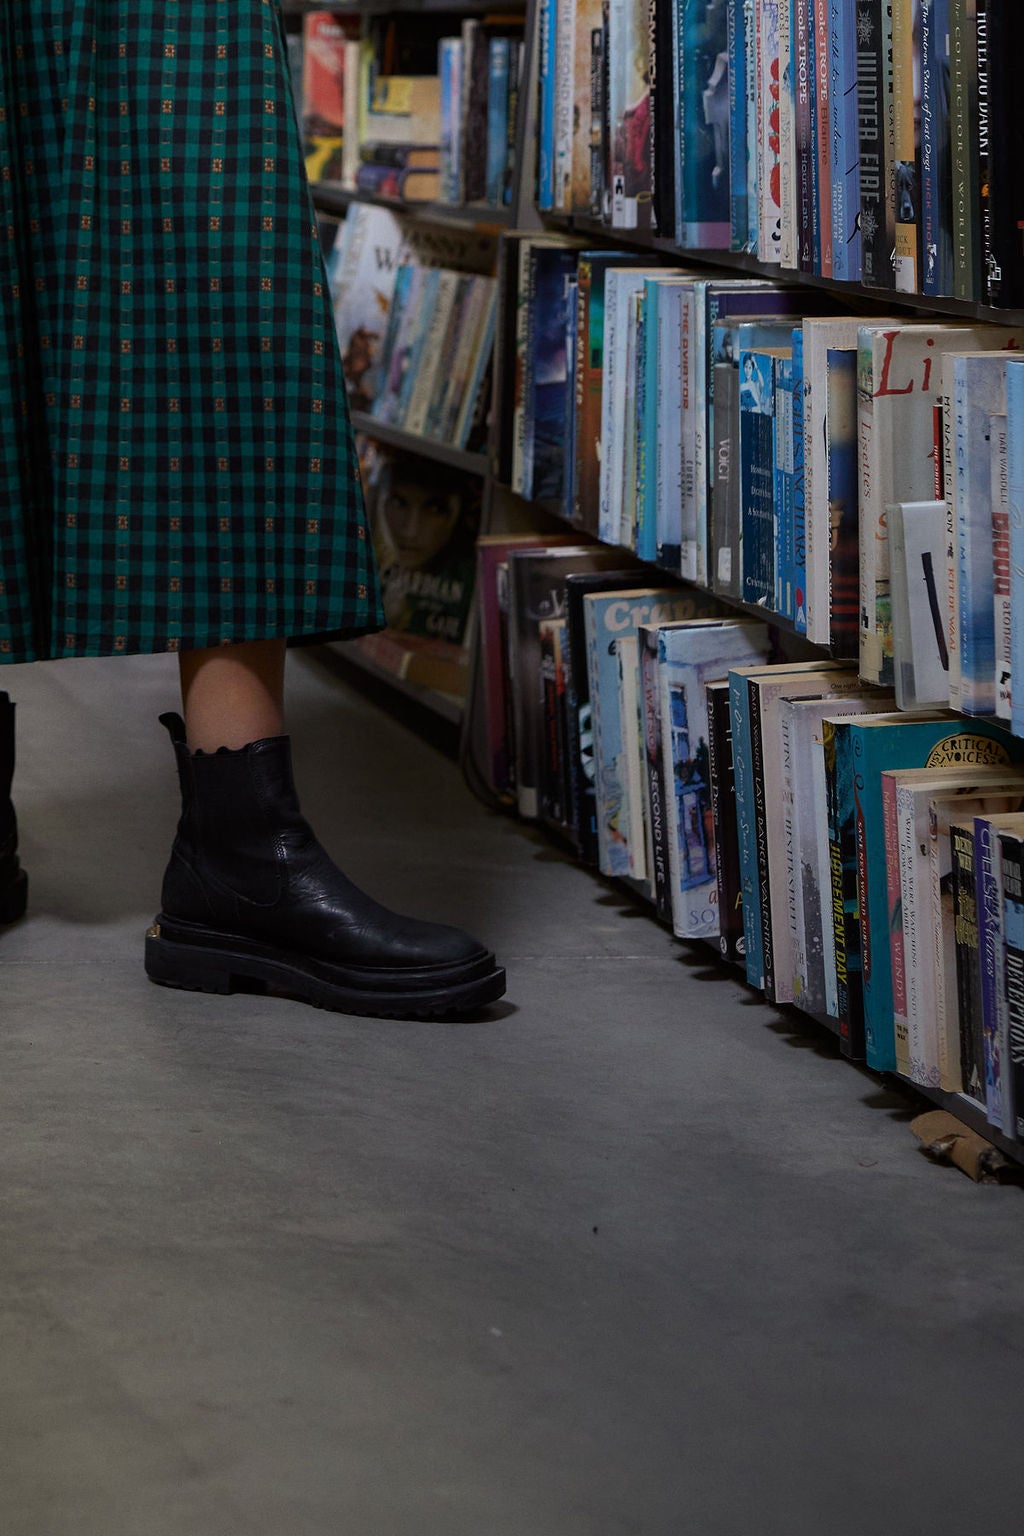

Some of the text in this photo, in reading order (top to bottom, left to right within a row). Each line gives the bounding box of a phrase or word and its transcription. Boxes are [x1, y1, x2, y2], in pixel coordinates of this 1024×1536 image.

[922, 4, 931, 25] The
[921, 28, 932, 67] Patron
[798, 43, 807, 104] TROPE
[819, 38, 828, 101] TROPE
[923, 70, 932, 102] Saint
[955, 27, 963, 149] COLLECTOR
[858, 51, 879, 204] WINTER FIRE
[921, 104, 932, 116] of
[923, 118, 932, 143] Lost
[821, 107, 829, 166] Blame
[801, 153, 809, 193] Hours
[922, 146, 933, 171] Dogs
[956, 159, 965, 174] of
[802, 198, 810, 229] Late
[958, 182, 966, 270] WORLDS
[806, 403, 812, 419] To
[943, 396, 950, 417] MY
[718, 439, 729, 482] VOIGT
[806, 436, 813, 458] Be
[861, 422, 872, 498] Lisette's
[794, 378, 804, 568] NIGHT SANCTUARY
[945, 473, 952, 487] IS
[999, 459, 1007, 506] WADDELL
[945, 491, 953, 534] LEON
[948, 592, 955, 611] DE
[942, 738, 1002, 756] CRITICAL
[946, 752, 988, 764] VOICES
[650, 770, 665, 884] SECOND LIFE
[752, 725, 760, 771] WAUGH
[761, 880, 771, 969] VALENTINO
[830, 842, 847, 984] JUDGEMENT DAY
[906, 855, 912, 872] WE
[909, 910, 917, 968] WATCHING
[982, 827, 995, 977] CHELSEA Wives
[894, 942, 903, 997] WENDY
[1007, 956, 1022, 1062] DECEPTIONS
